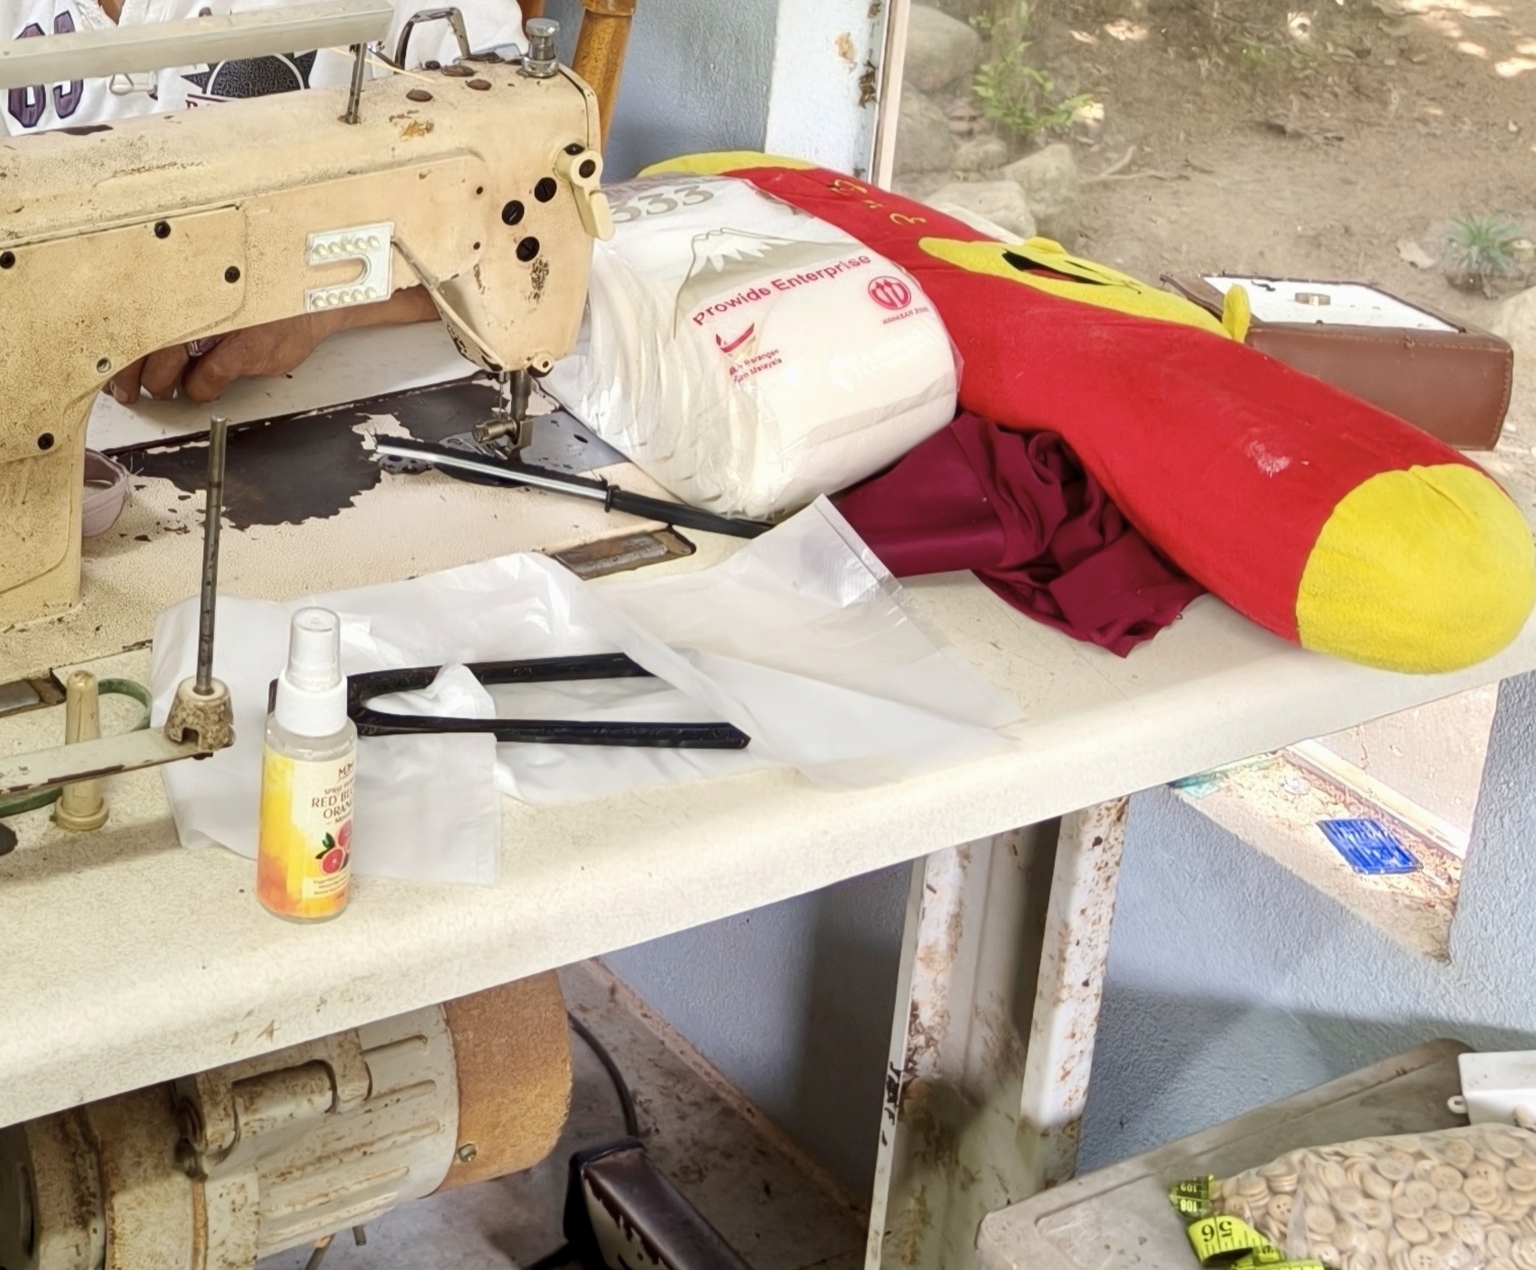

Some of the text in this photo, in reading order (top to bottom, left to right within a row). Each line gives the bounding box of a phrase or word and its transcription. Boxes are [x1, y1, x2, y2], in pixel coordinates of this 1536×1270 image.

[692, 254, 872, 327] Prowide Enterprise
[311, 795, 337, 808] RED
